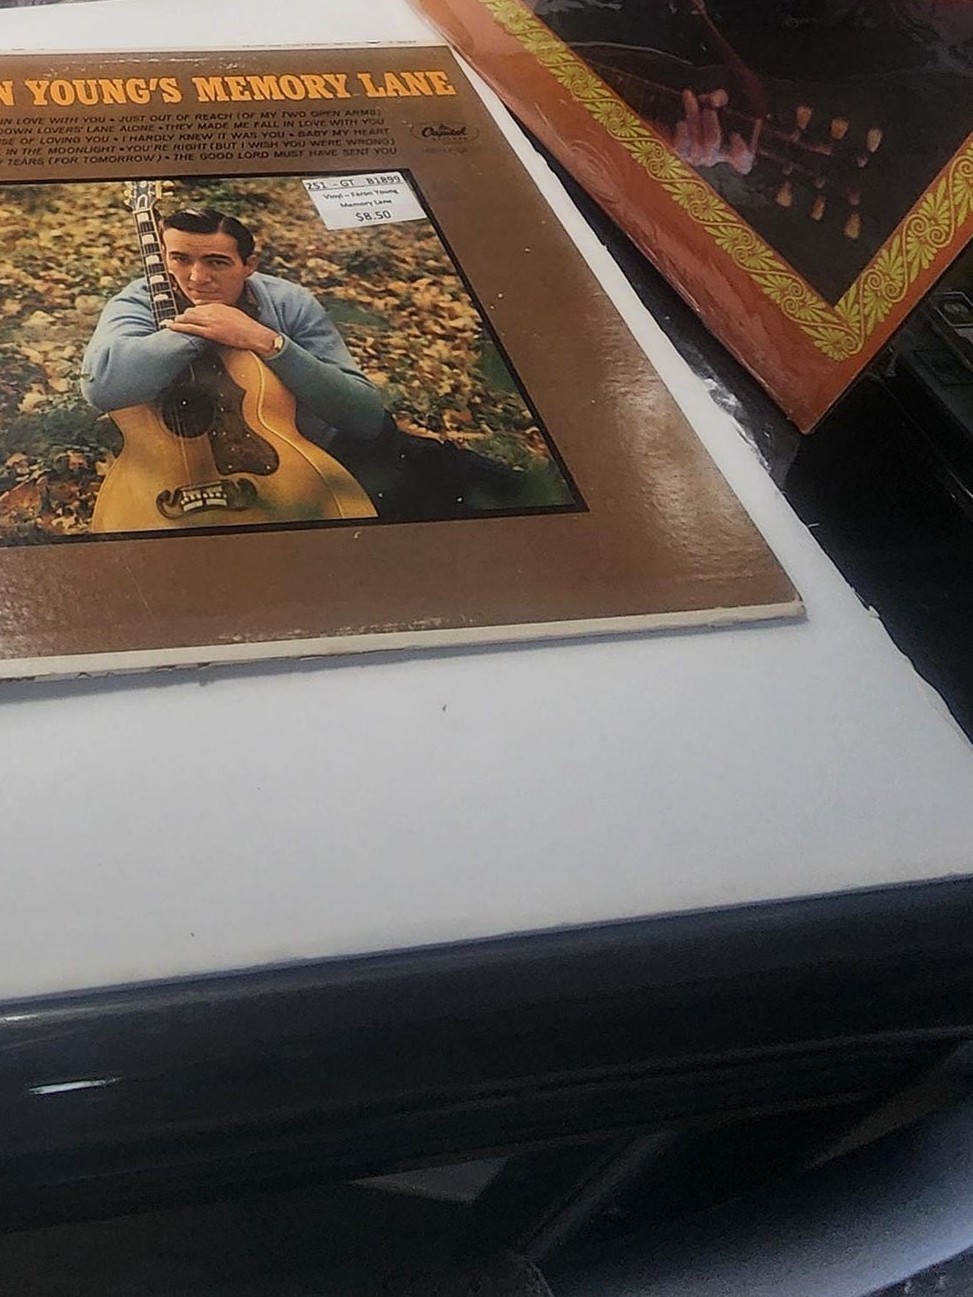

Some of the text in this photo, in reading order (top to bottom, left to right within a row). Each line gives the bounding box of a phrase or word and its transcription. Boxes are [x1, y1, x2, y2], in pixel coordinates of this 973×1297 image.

[25, 77, 184, 106] YOUNG'S
[193, 74, 353, 103] MEMORY
[358, 71, 457, 98] LANE
[48, 156, 78, 165] (FOR
[83, 154, 162, 164] TOMORROW)
[174, 152, 195, 161] THE
[200, 152, 233, 161] GOOD
[237, 151, 269, 160] LORD
[375, 147, 397, 156] YOU
[355, 210, 392, 222] $8.50
